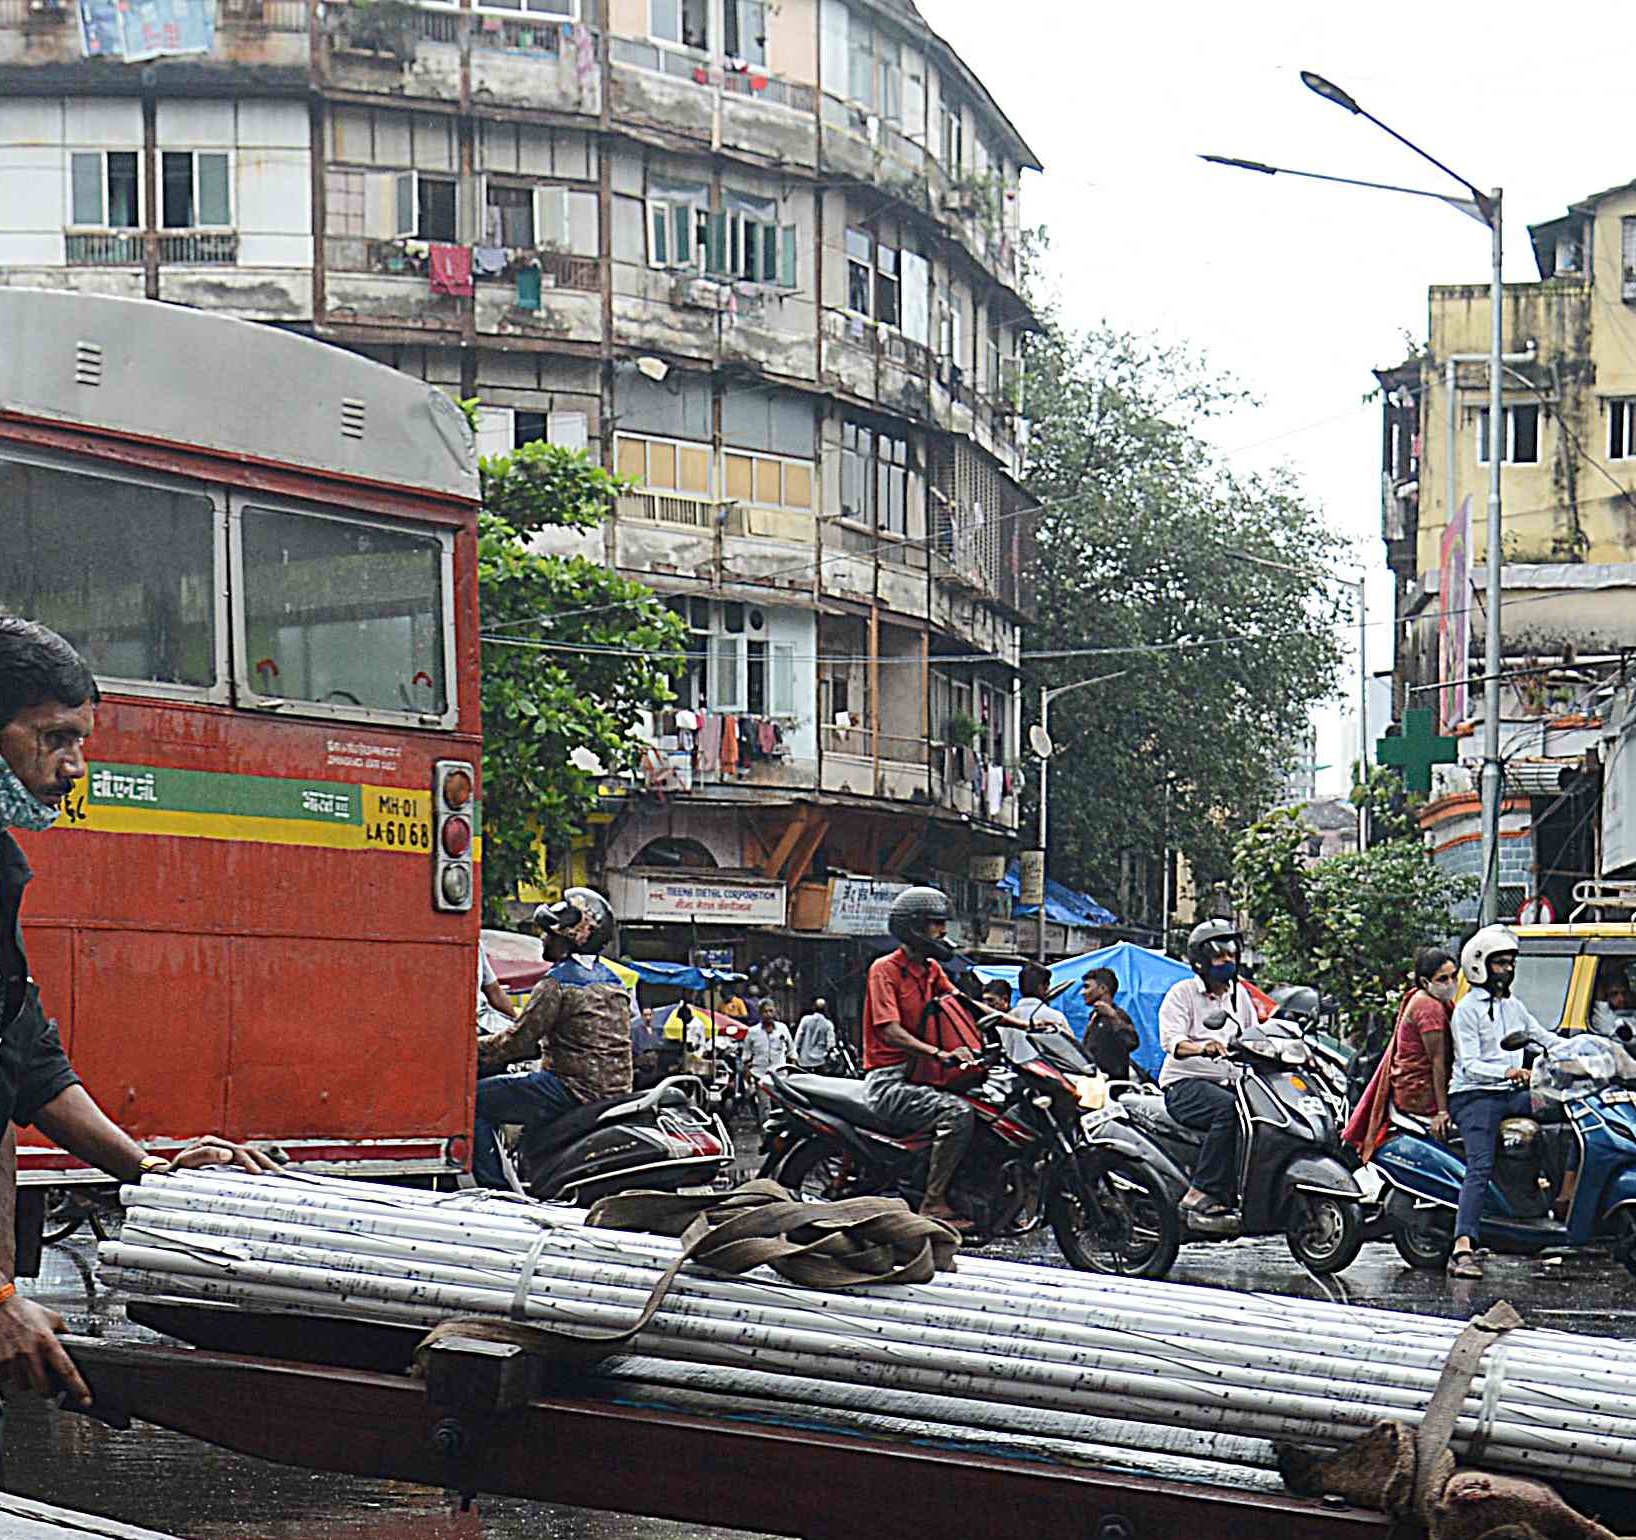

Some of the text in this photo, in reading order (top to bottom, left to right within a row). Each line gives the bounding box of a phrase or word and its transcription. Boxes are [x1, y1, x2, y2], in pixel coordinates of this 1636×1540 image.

[378, 795, 418, 818] MH-01
[366, 820, 430, 849] LA-6068
[695, 886, 722, 899] METAL
[723, 888, 777, 901] CORPORATION
